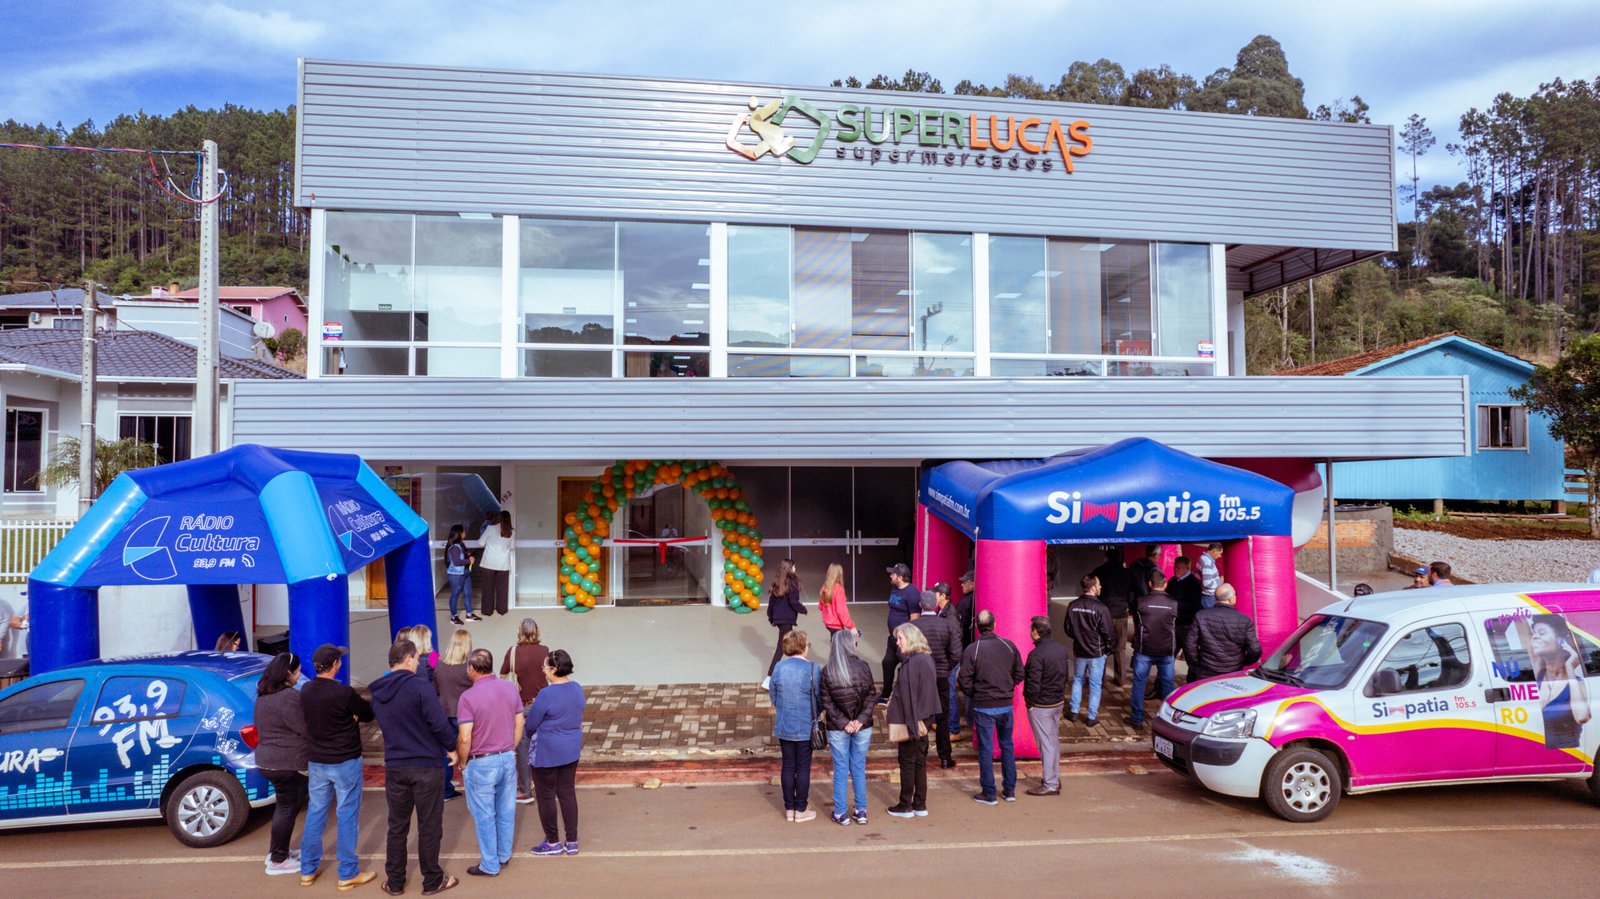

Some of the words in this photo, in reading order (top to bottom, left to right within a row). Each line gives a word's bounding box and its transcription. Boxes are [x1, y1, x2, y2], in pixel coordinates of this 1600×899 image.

[837, 145, 1052, 172] supermercados
[1219, 494, 1241, 508] fm
[179, 513, 235, 531] RÁDIO
[1219, 506, 1261, 521] 105.5
[175, 533, 261, 552] Cultura
[219, 558, 236, 568] FM
[1510, 684, 1540, 701] ME
[1455, 701, 1478, 709] 105.5
[1500, 706, 1529, 725] RO
[112, 712, 170, 768] FM
